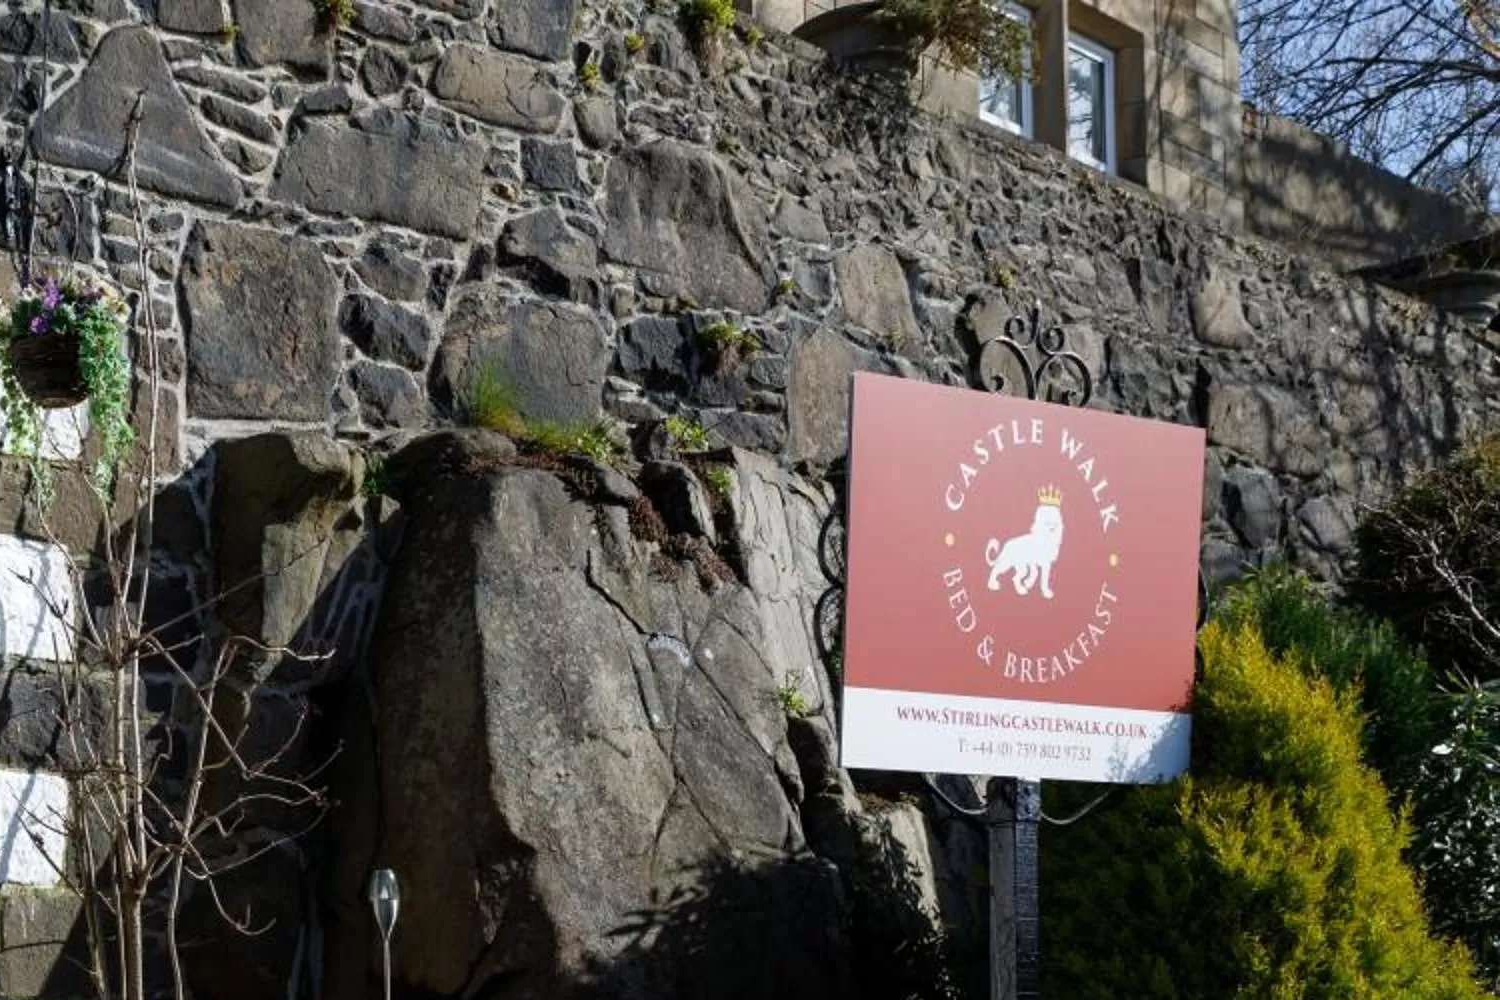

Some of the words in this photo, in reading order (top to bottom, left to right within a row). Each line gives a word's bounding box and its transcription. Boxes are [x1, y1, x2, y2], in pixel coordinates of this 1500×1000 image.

[945, 419, 1044, 511] CASTLE
[1059, 428, 1119, 532] WALK
[943, 567, 978, 633] BED
[977, 635, 995, 665] &
[1004, 581, 1119, 683] BREAKFAST
[973, 741, 993, 755] +44
